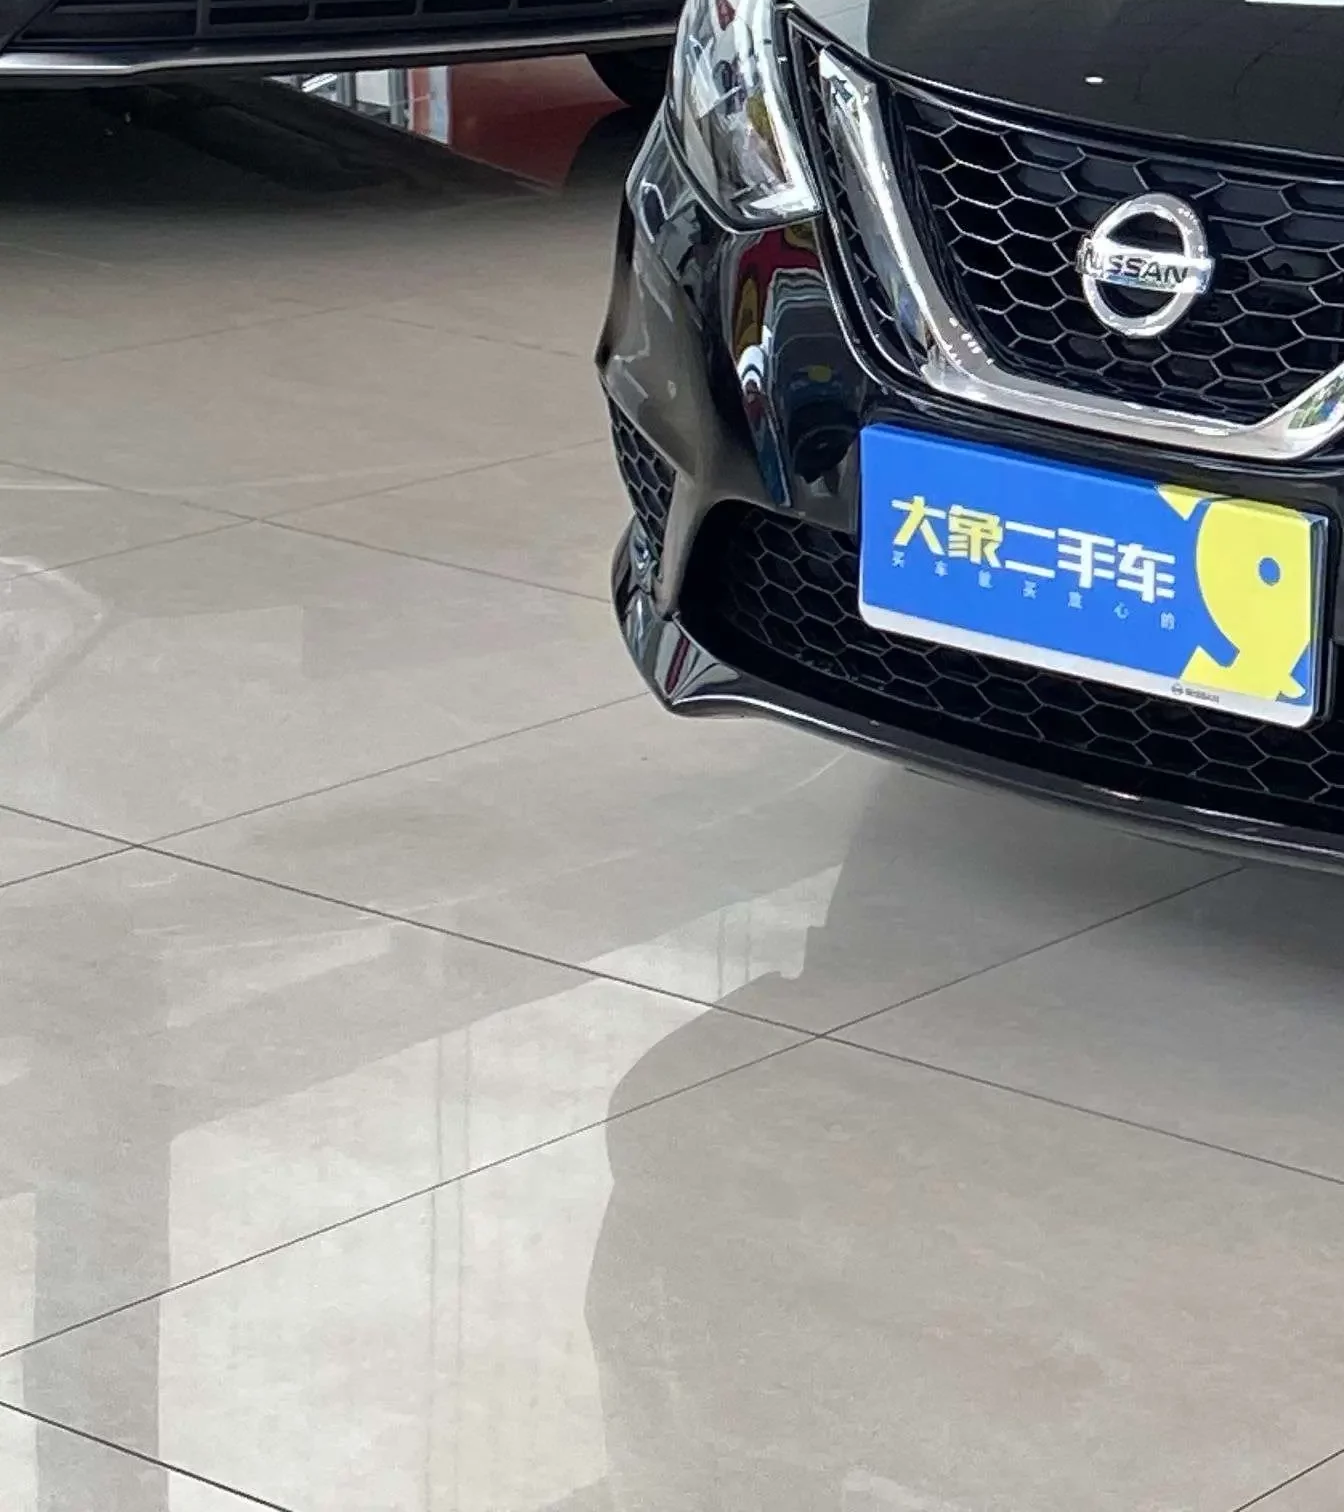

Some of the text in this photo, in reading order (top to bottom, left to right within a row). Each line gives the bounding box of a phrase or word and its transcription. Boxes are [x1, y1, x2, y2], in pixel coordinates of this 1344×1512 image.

[1080, 240, 1189, 285] NSSAN
[891, 496, 1175, 604] 大象二手车
